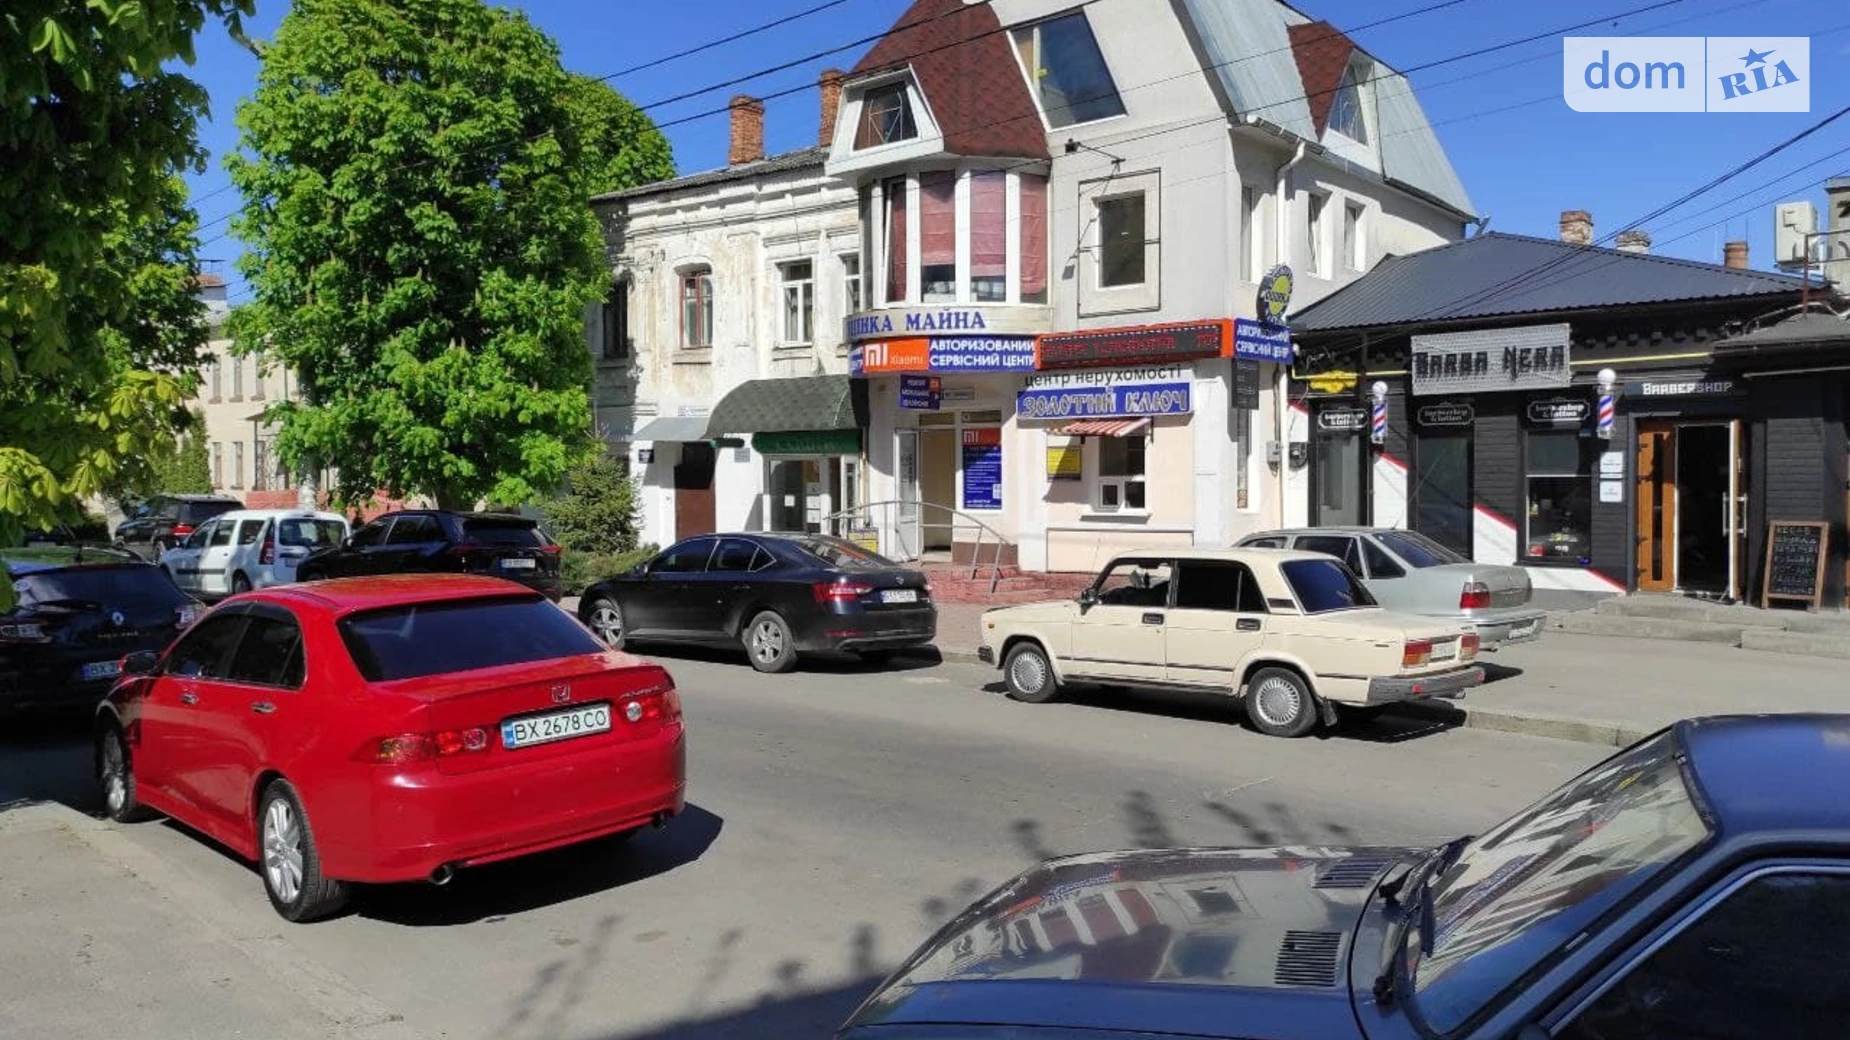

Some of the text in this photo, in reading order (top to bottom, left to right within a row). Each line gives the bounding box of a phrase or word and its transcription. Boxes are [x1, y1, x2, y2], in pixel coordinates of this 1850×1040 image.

[905, 308, 987, 332] МАЙНА
[930, 353, 1000, 367] СЕРВІСНИЙ
[1025, 364, 1182, 388] центр нерухомості
[1021, 387, 1188, 418] ЗОЛОТИЙ КЛЮЧ
[543, 714, 581, 737] 2678
